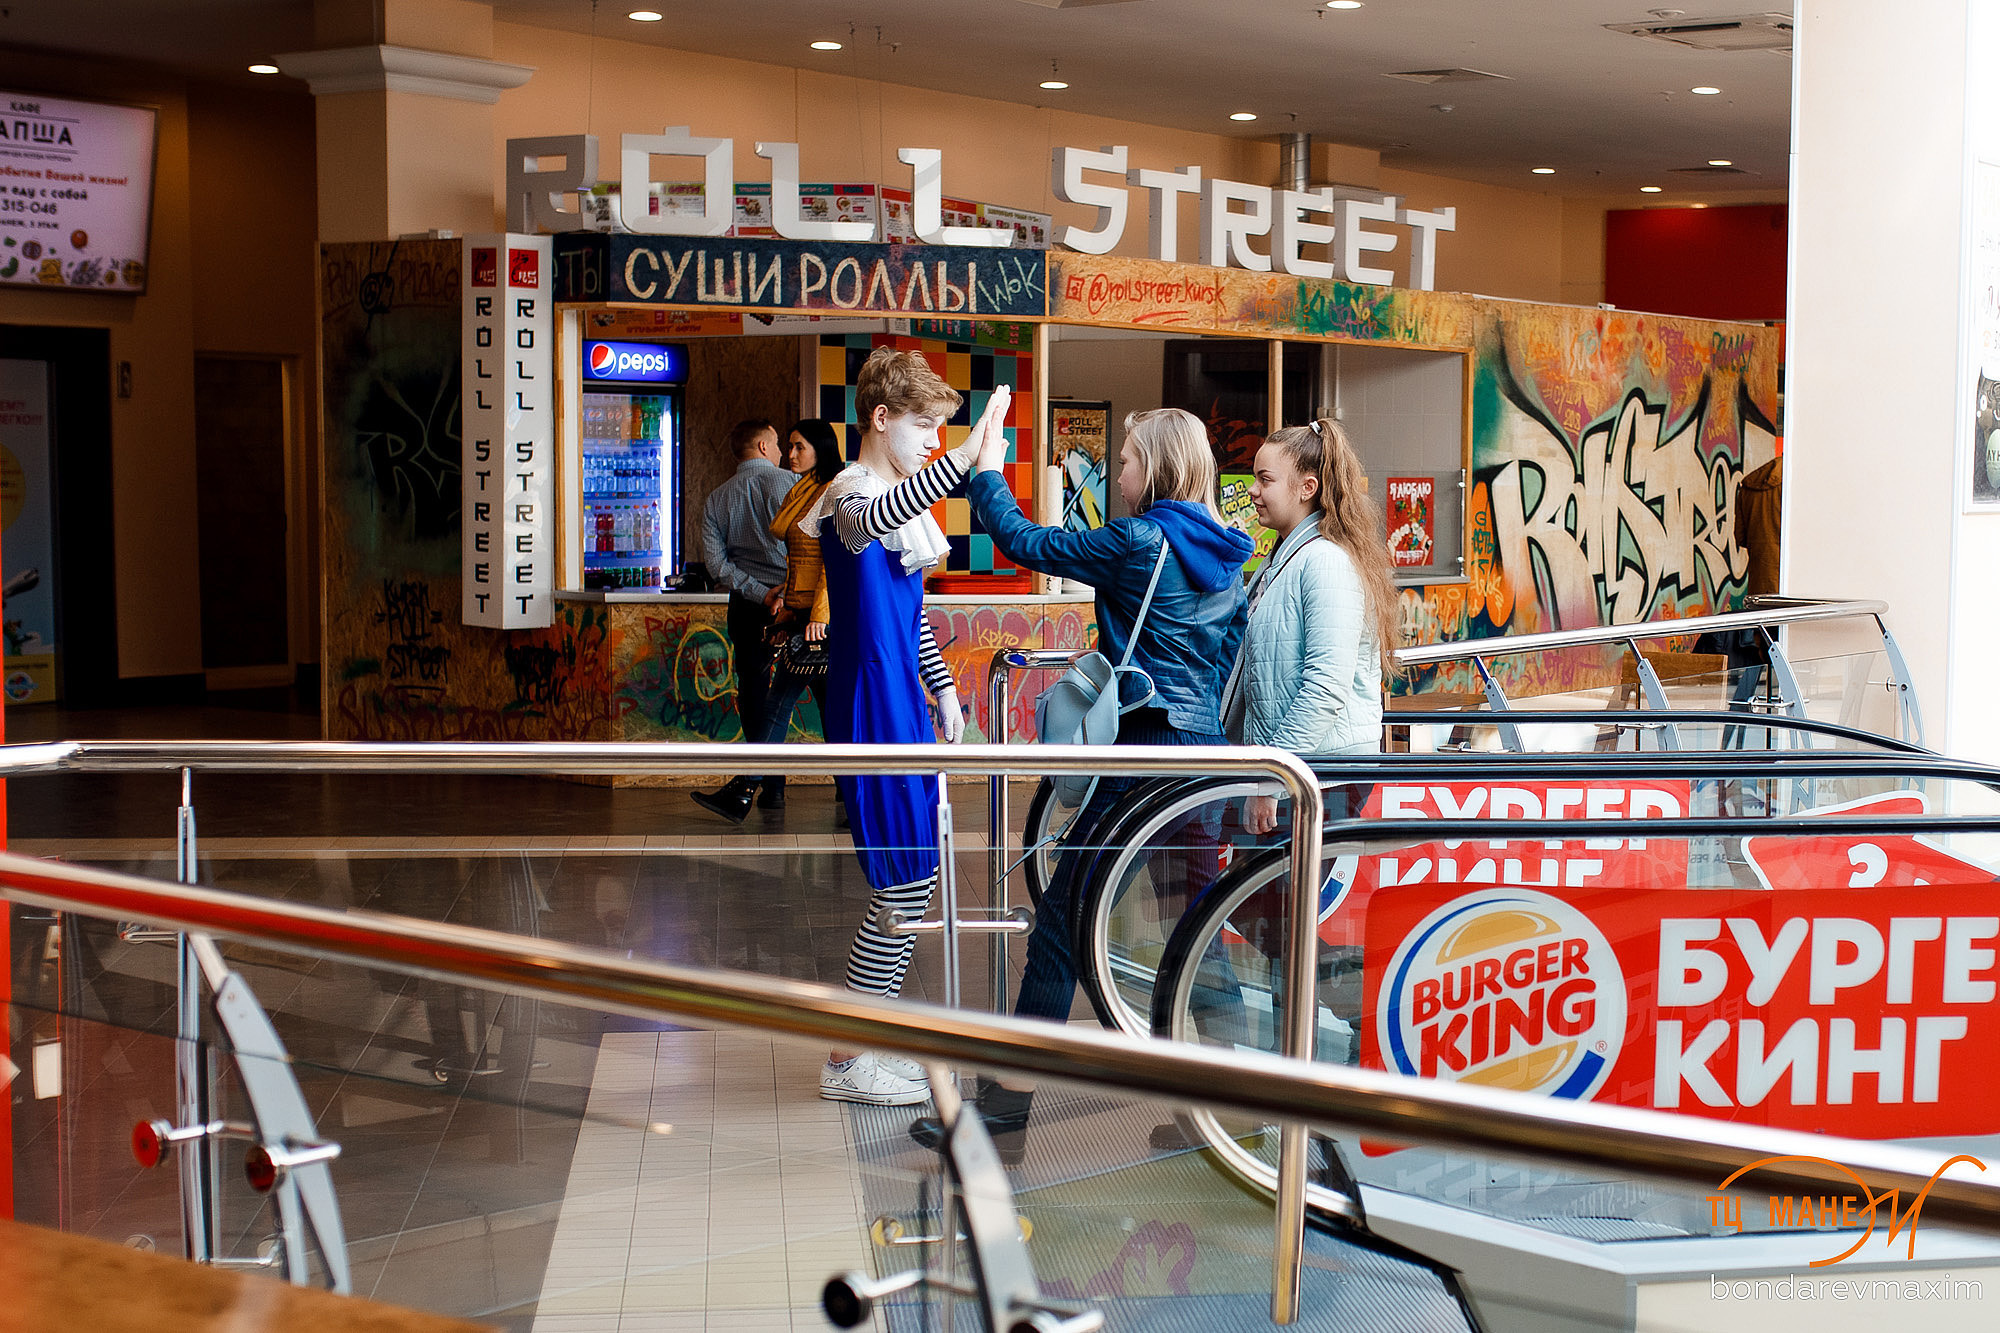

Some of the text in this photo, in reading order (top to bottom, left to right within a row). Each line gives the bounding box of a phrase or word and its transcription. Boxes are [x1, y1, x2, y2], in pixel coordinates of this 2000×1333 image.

[10, 101, 41, 114] КАФЕ
[51, 188, 88, 201] собой
[506, 126, 1457, 291] ROLL STREET
[623, 247, 782, 306] СУШИ
[800, 253, 977, 314] РОЛЛЫ
[617, 351, 670, 375] pepsi
[474, 296, 493, 614] ROLL STREET
[515, 298, 535, 615] ROLL STREET
[1068, 417, 1093, 427] ROLL
[1068, 426, 1104, 436] STREET
[1397, 482, 1432, 505] ЛЮБЛЮ
[1412, 938, 1590, 1027] BURGER
[1657, 917, 2000, 1009] БУРГЕ
[1419, 978, 1597, 1081] KING
[1653, 1016, 1968, 1108] КИНГ
